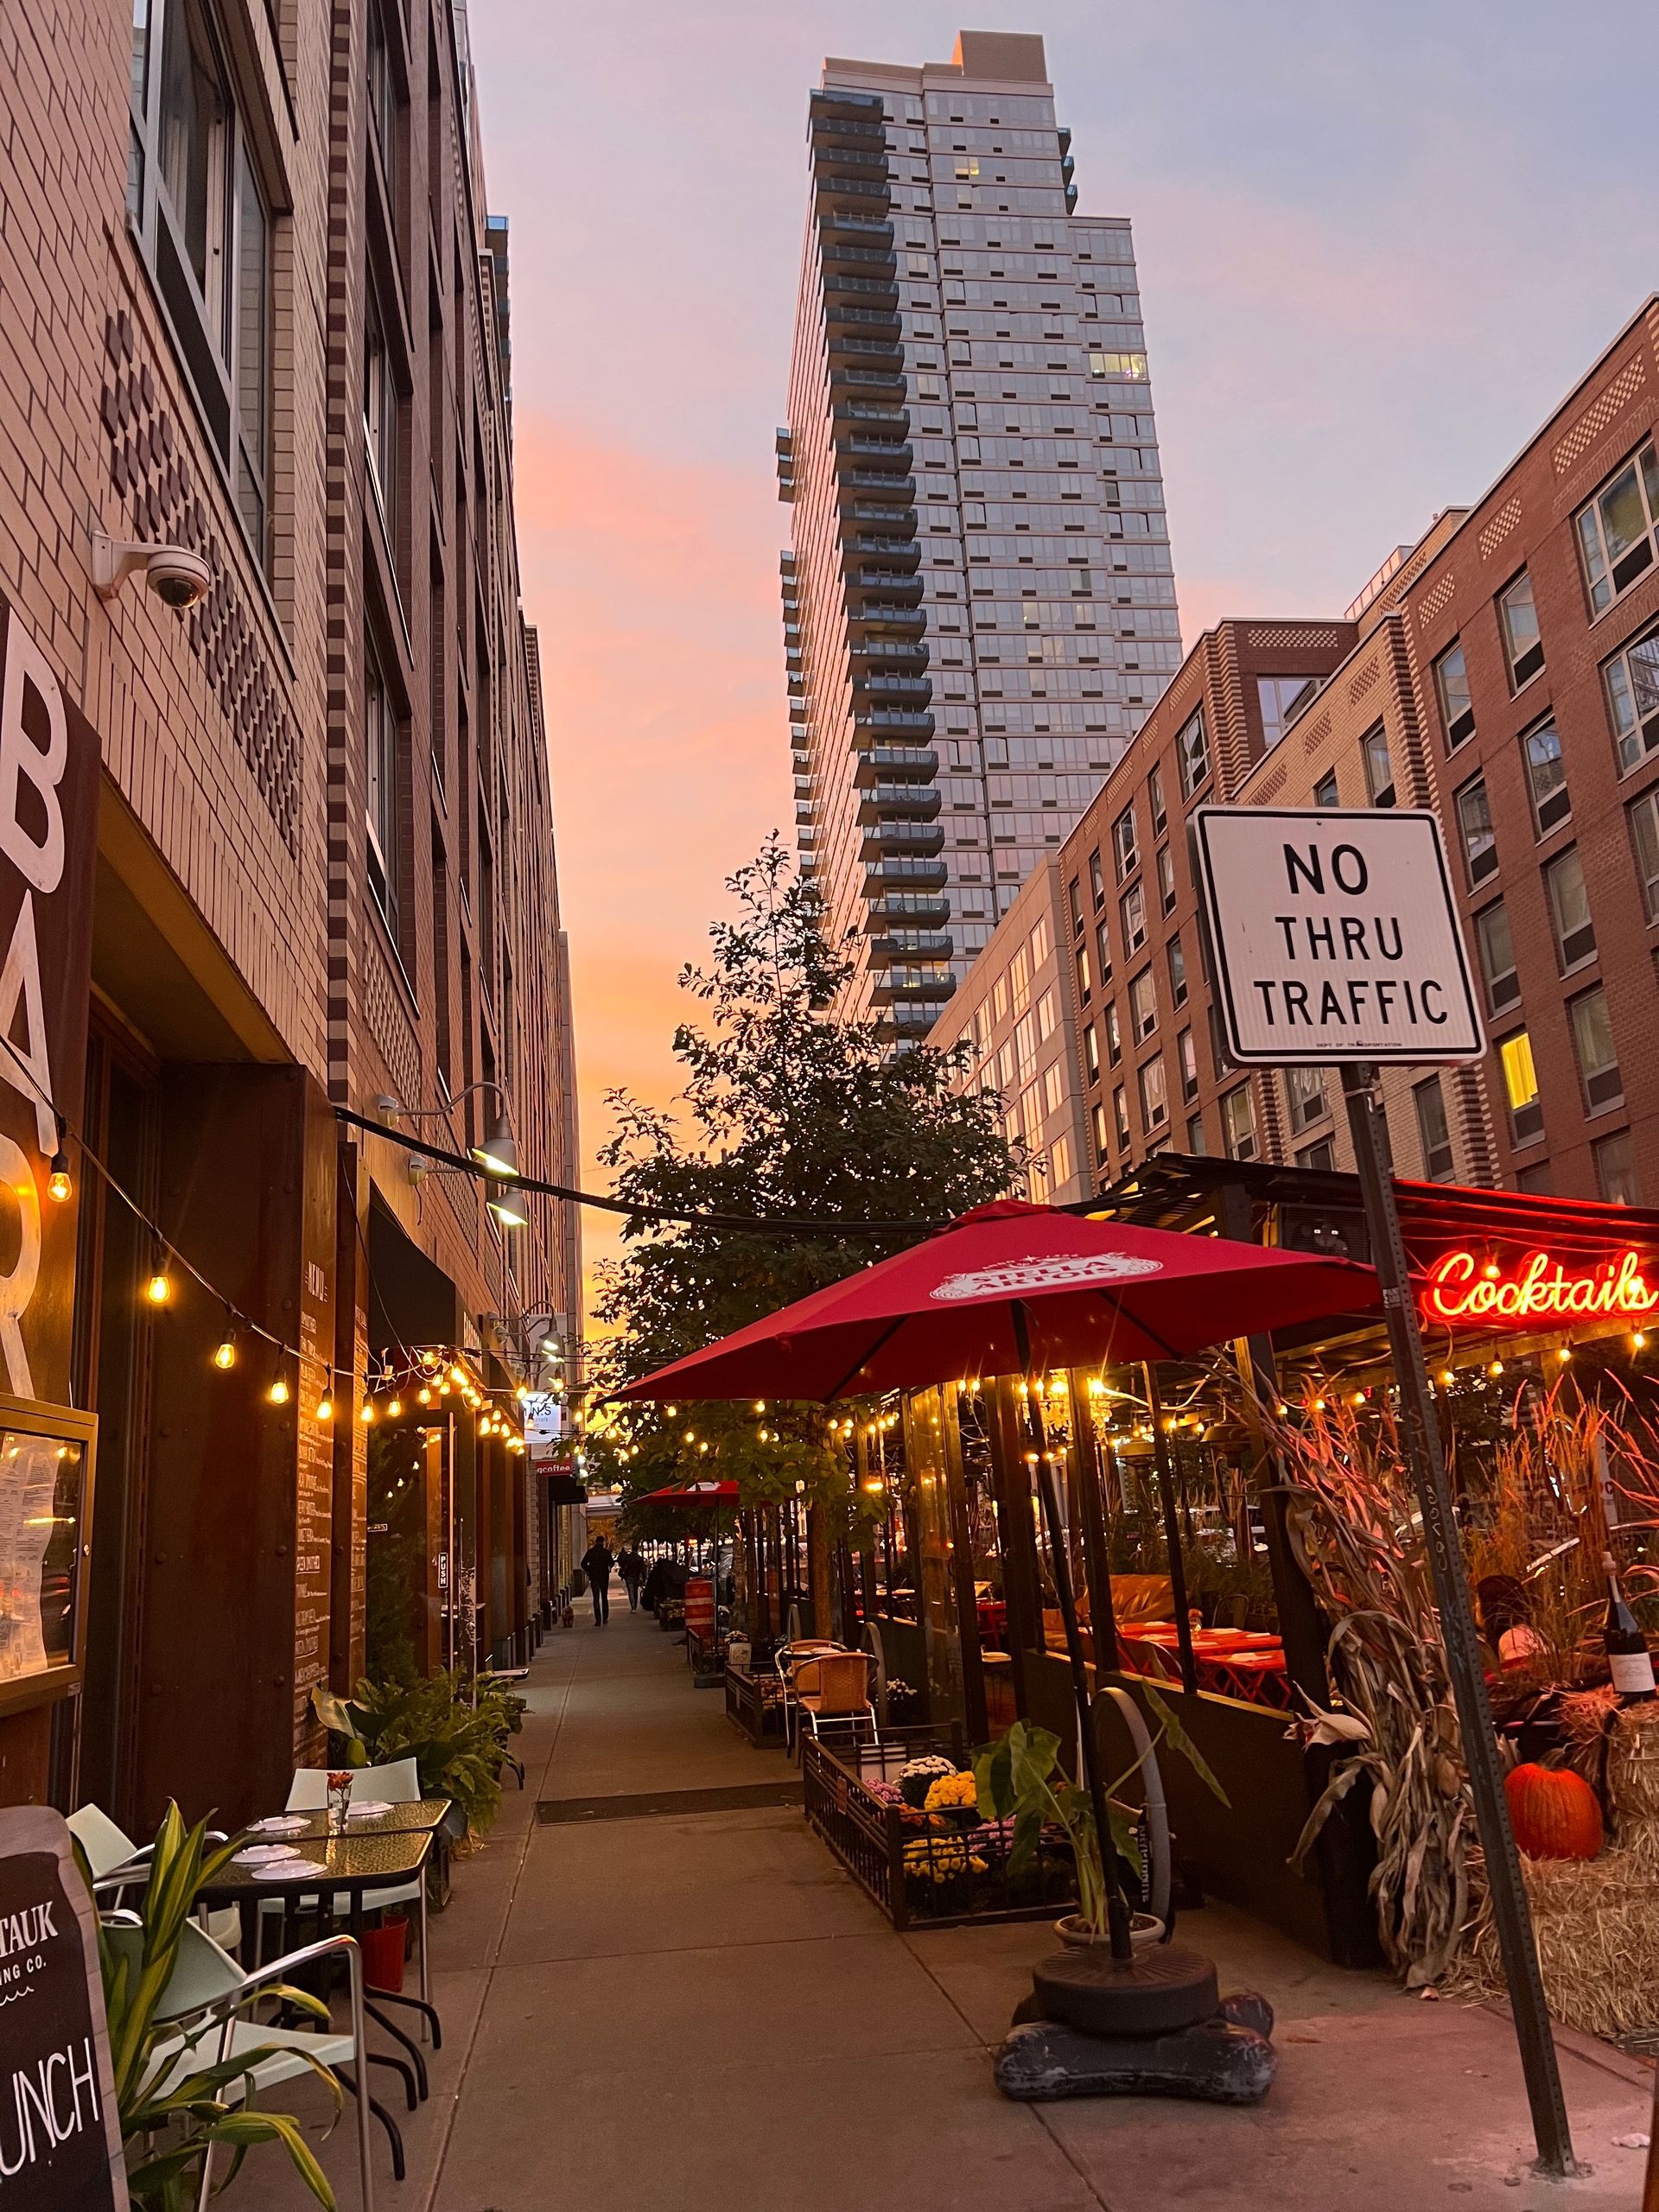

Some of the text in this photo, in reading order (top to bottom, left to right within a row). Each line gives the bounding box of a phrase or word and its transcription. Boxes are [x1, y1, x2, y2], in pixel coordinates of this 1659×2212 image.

[1282, 843, 1369, 895] NO
[1274, 916, 1403, 961] THRU
[1254, 979, 1448, 1026] TRAFFIC
[972, 1261, 1109, 1283] STELLA
[976, 1267, 1118, 1290] ARTOIS
[1433, 1250, 1659, 1316] Cocktails
[26, 1955, 47, 1974] CO.
